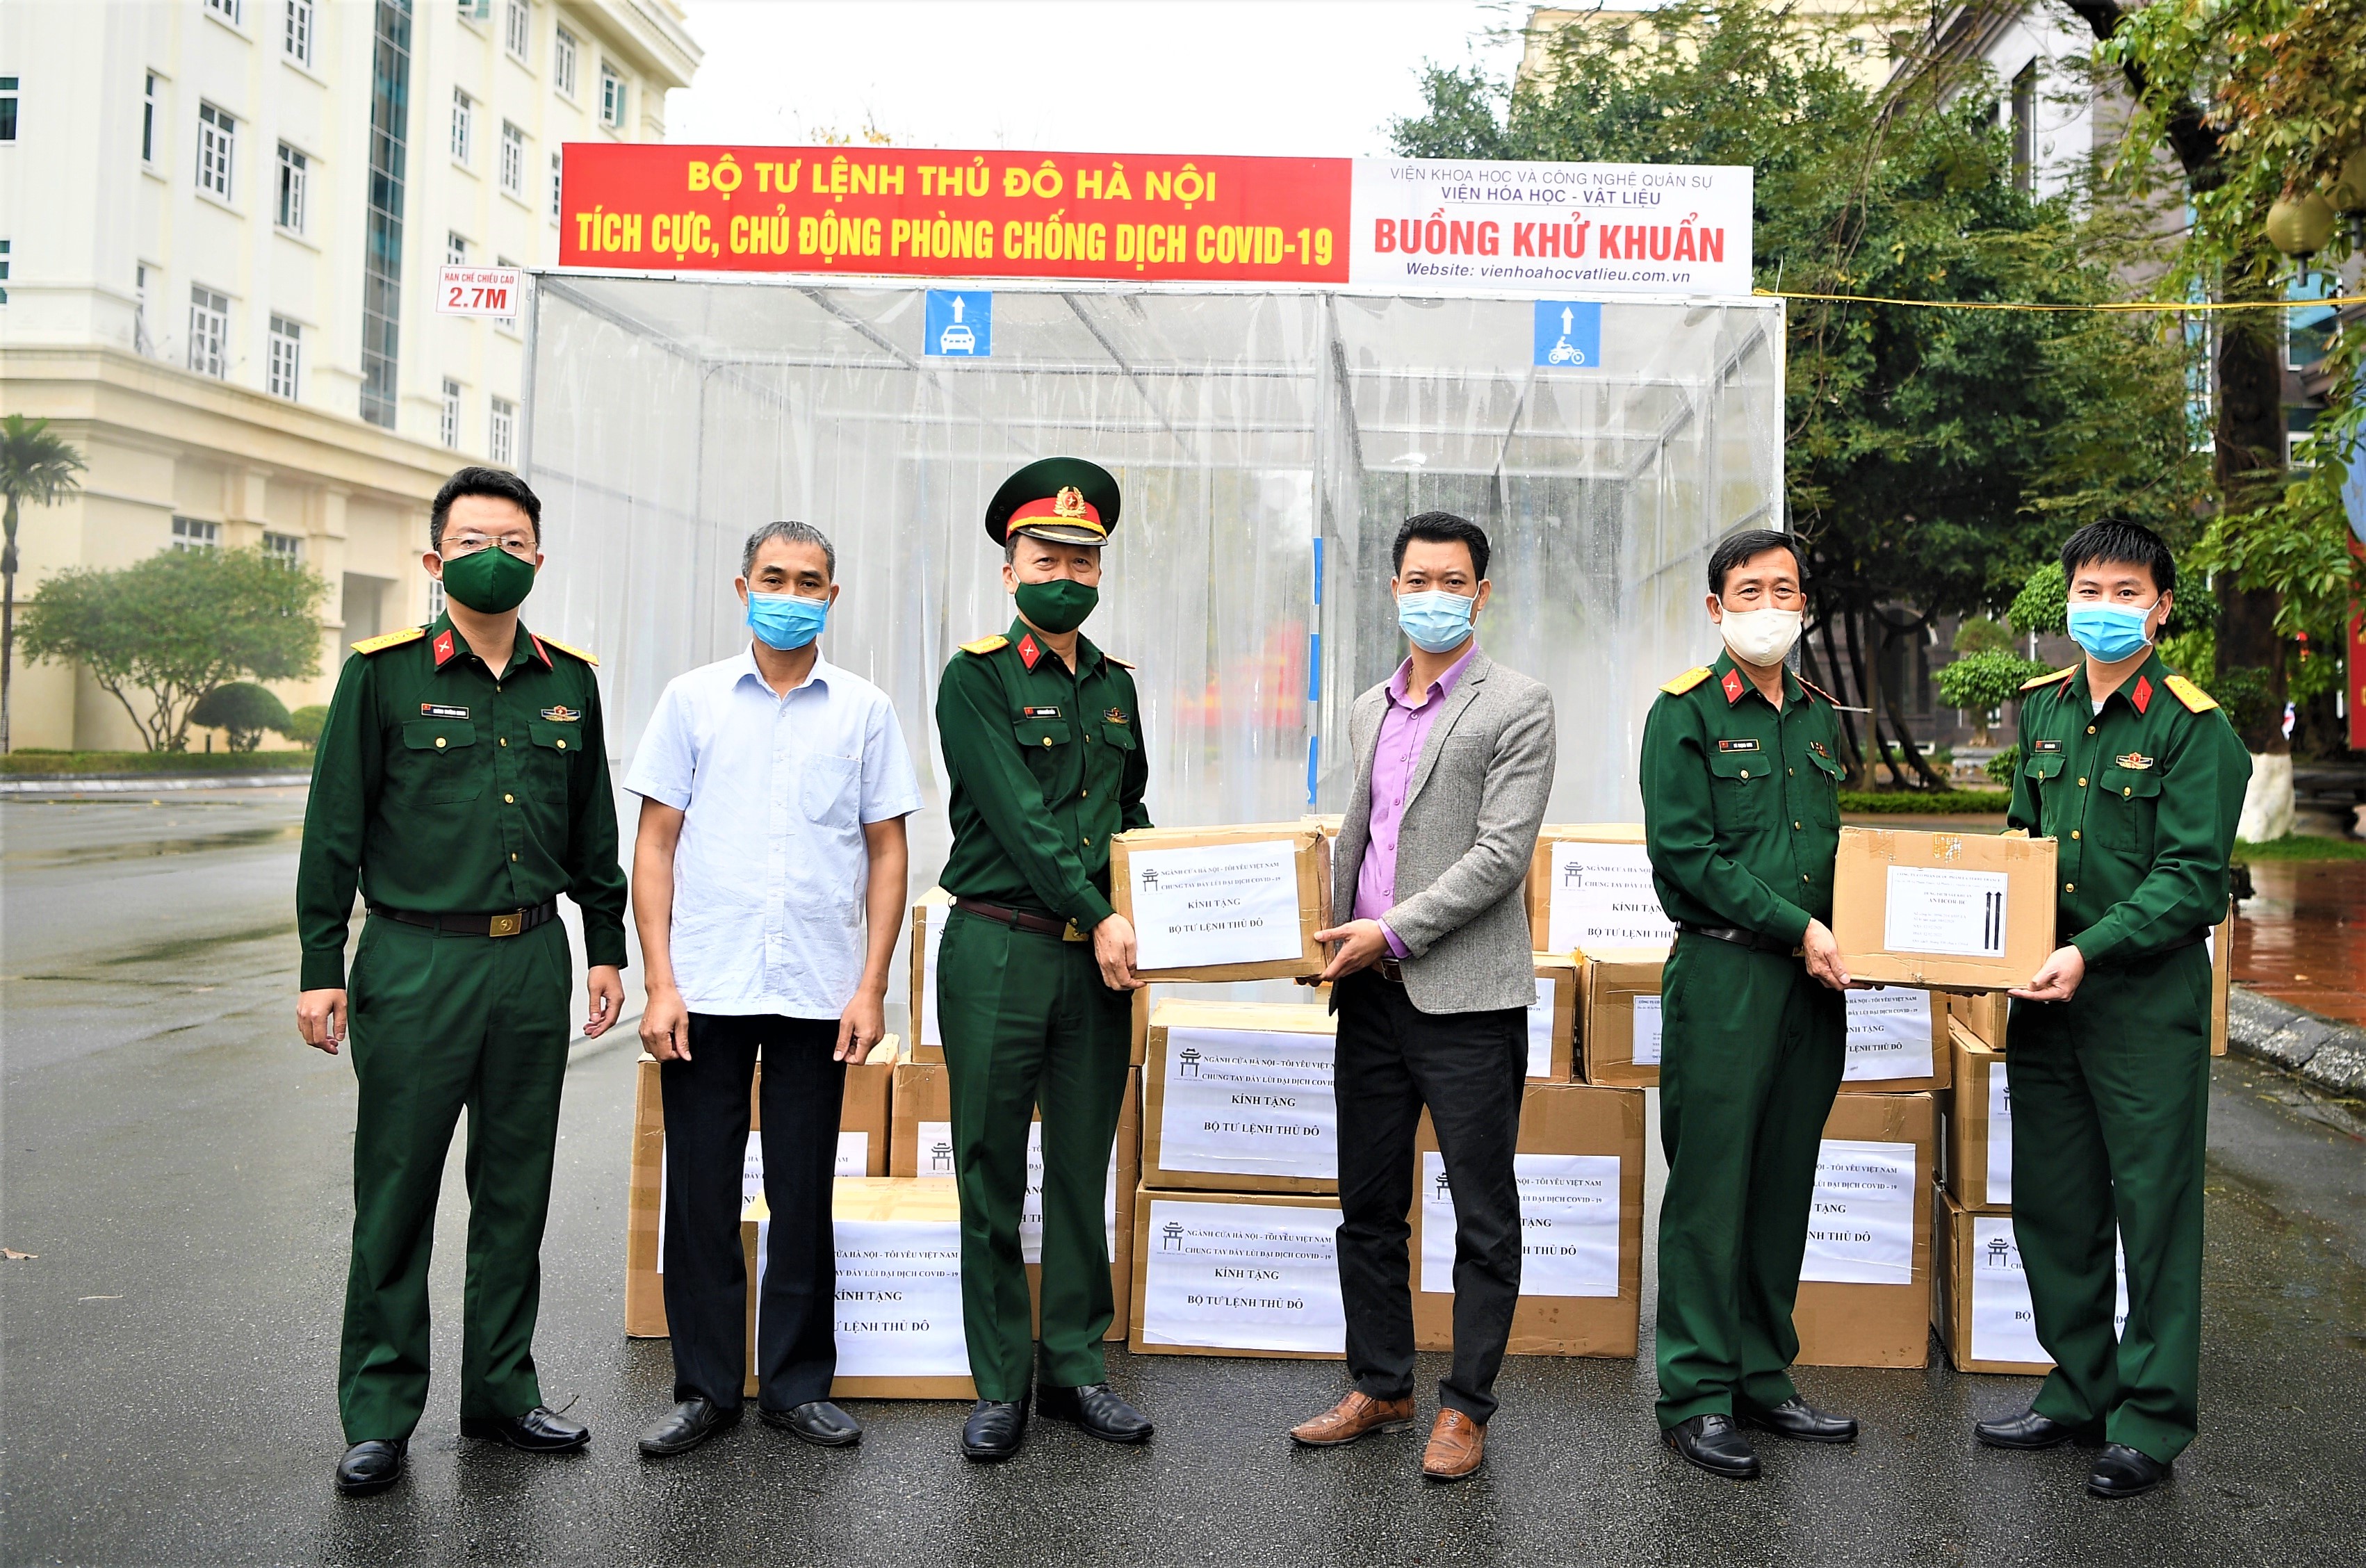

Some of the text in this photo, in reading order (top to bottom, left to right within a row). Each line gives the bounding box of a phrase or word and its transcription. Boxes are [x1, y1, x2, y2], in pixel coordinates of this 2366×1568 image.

[688, 153, 1216, 211] BỘ TƯ LỆNH THỦ ĐÔ HÀ NỘI
[1390, 165, 1713, 190] VIỆN KHOA HỌC VÀ CÔNG NGHỆ QUÂN SỰ
[1441, 185, 1480, 202] VIỆN
[1487, 186, 1523, 201] HÓA
[1529, 188, 1566, 204] HỌC
[1583, 188, 1617, 206] VẬT
[1622, 189, 1661, 207] LIỆU
[576, 203, 1333, 271] TÍCH CỰC, CHỦ ĐỘNG PHÒNG CHỐNG DỊCH COVID-19
[1374, 207, 1724, 263] BUỒNG KHỬ KHUẨN
[500, 275, 514, 284] CAO
[1407, 262, 1690, 283] Website: vienhoahocvatlieu.com.vn
[448, 287, 507, 309] 2.7M
[1232, 1093, 1296, 1108] KÍNH TẶNG
[1204, 1121, 1319, 1136] BỘ TƯ LỆNH THỦ ĐÔ
[1815, 1203, 1846, 1214] TẶNG
[1520, 1218, 1551, 1228] TẶNG
[1828, 1231, 1851, 1241] THỦ
[1855, 1231, 1870, 1241] ĐÔ
[1533, 1244, 1557, 1255] THỦ
[1560, 1245, 1576, 1255] ĐÔ
[1215, 1266, 1279, 1281] KÍNH TẶNG
[834, 1289, 902, 1302] KÍNH TẶNG
[1188, 1295, 1303, 1309] BỘ TƯ LỆNH THỦ ĐÔ
[2015, 1310, 2031, 1322] BỘ
[845, 1321, 878, 1334] LỆNH
[881, 1320, 907, 1331] THỦ
[912, 1319, 929, 1331] ĐÔ
